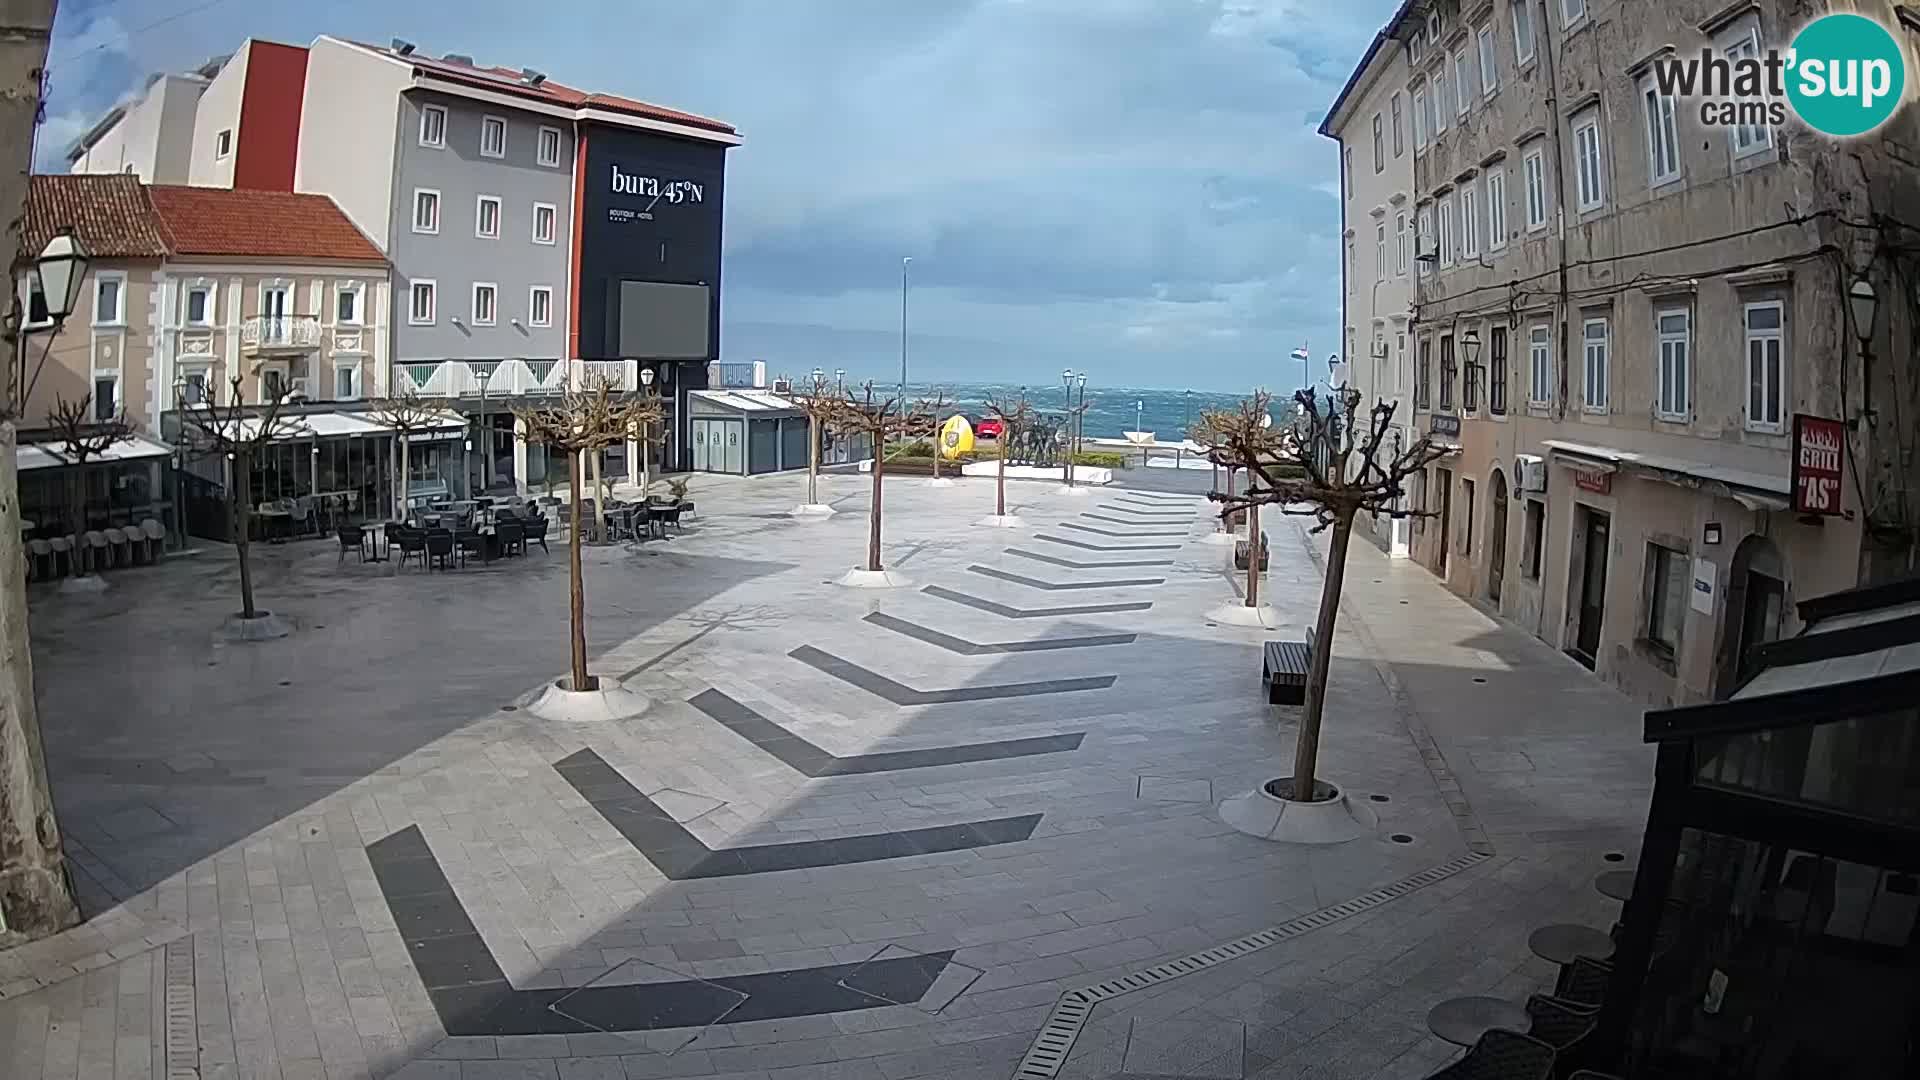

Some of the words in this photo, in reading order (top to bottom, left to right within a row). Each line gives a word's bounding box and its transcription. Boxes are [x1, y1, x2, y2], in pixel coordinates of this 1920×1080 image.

[612, 165, 658, 196] bura
[609, 209, 634, 218] BOUTIQUE
[637, 212, 653, 220] HOTEL
[1800, 448, 1840, 472] GRILL
